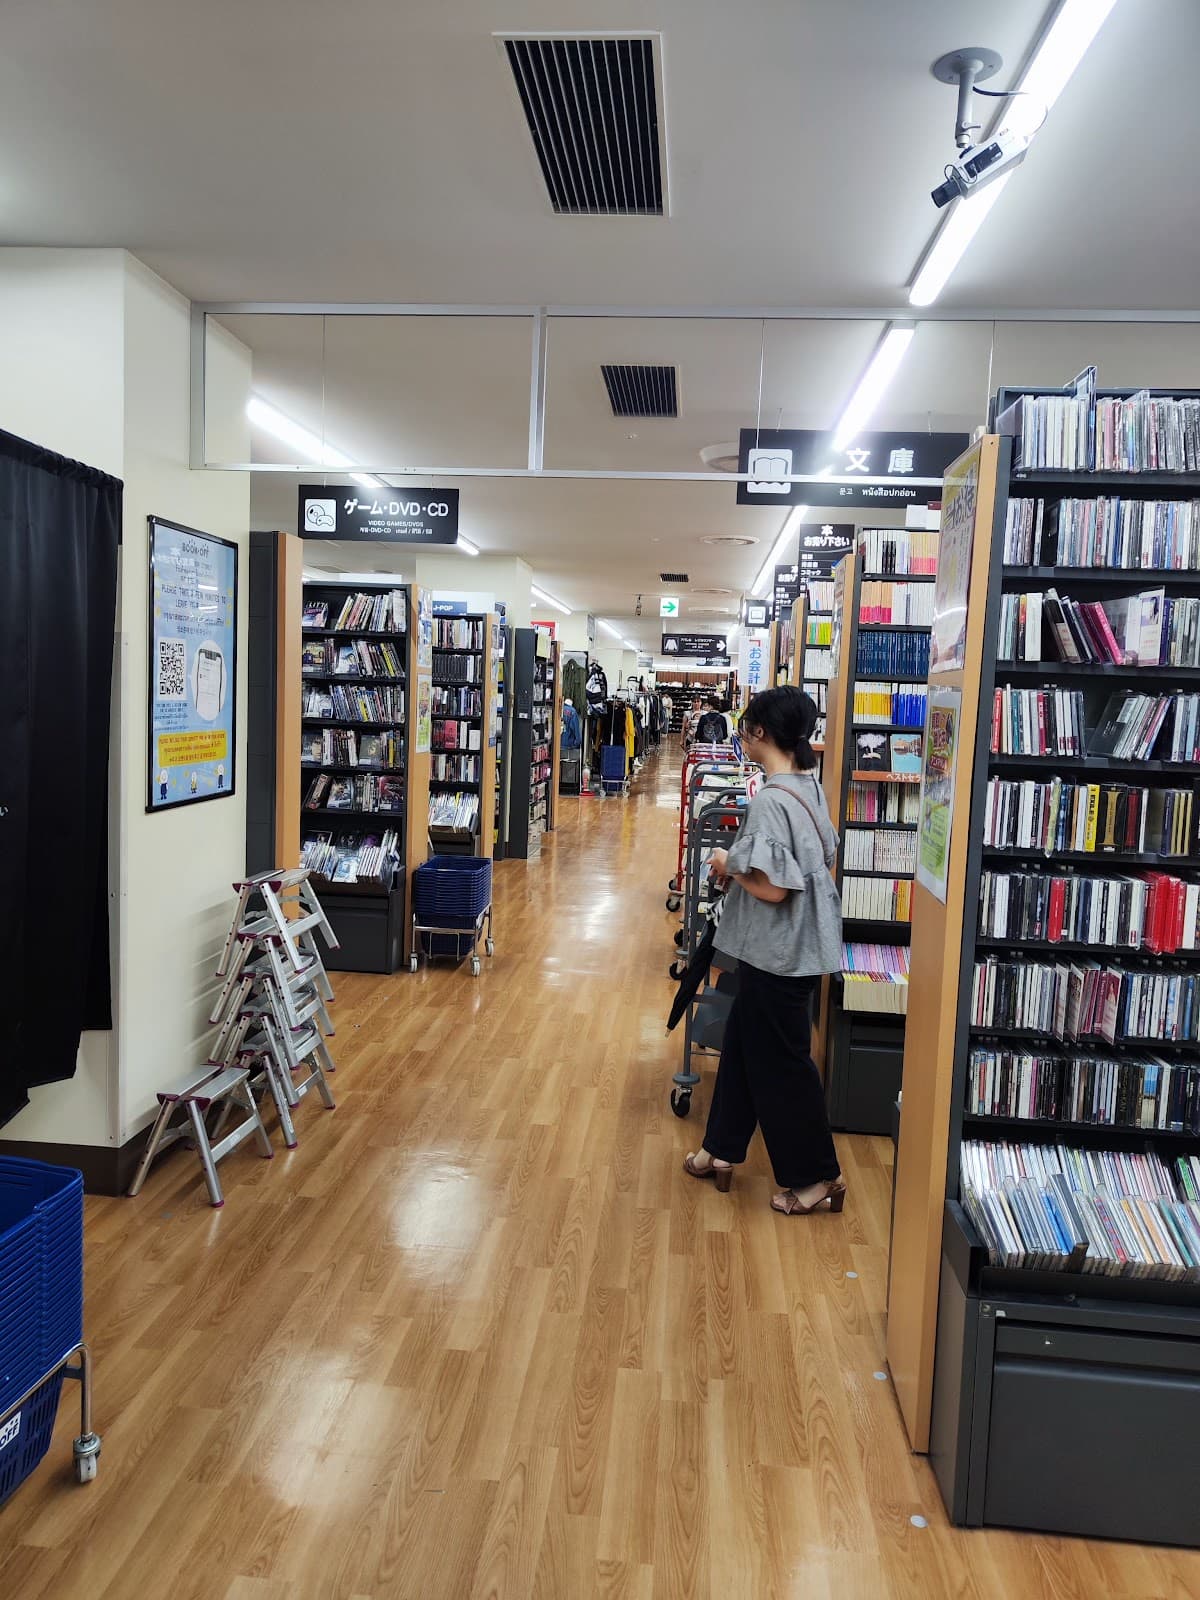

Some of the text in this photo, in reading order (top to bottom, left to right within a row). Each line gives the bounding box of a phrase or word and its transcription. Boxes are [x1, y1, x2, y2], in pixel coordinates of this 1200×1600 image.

[845, 447, 915, 473] 文庫
[368, 519, 386, 527] VIDEO
[822, 525, 834, 536] 本
[804, 536, 850, 547] お売り下さい
[433, 604, 454, 612] J-POP
[748, 646, 763, 685] お会計
